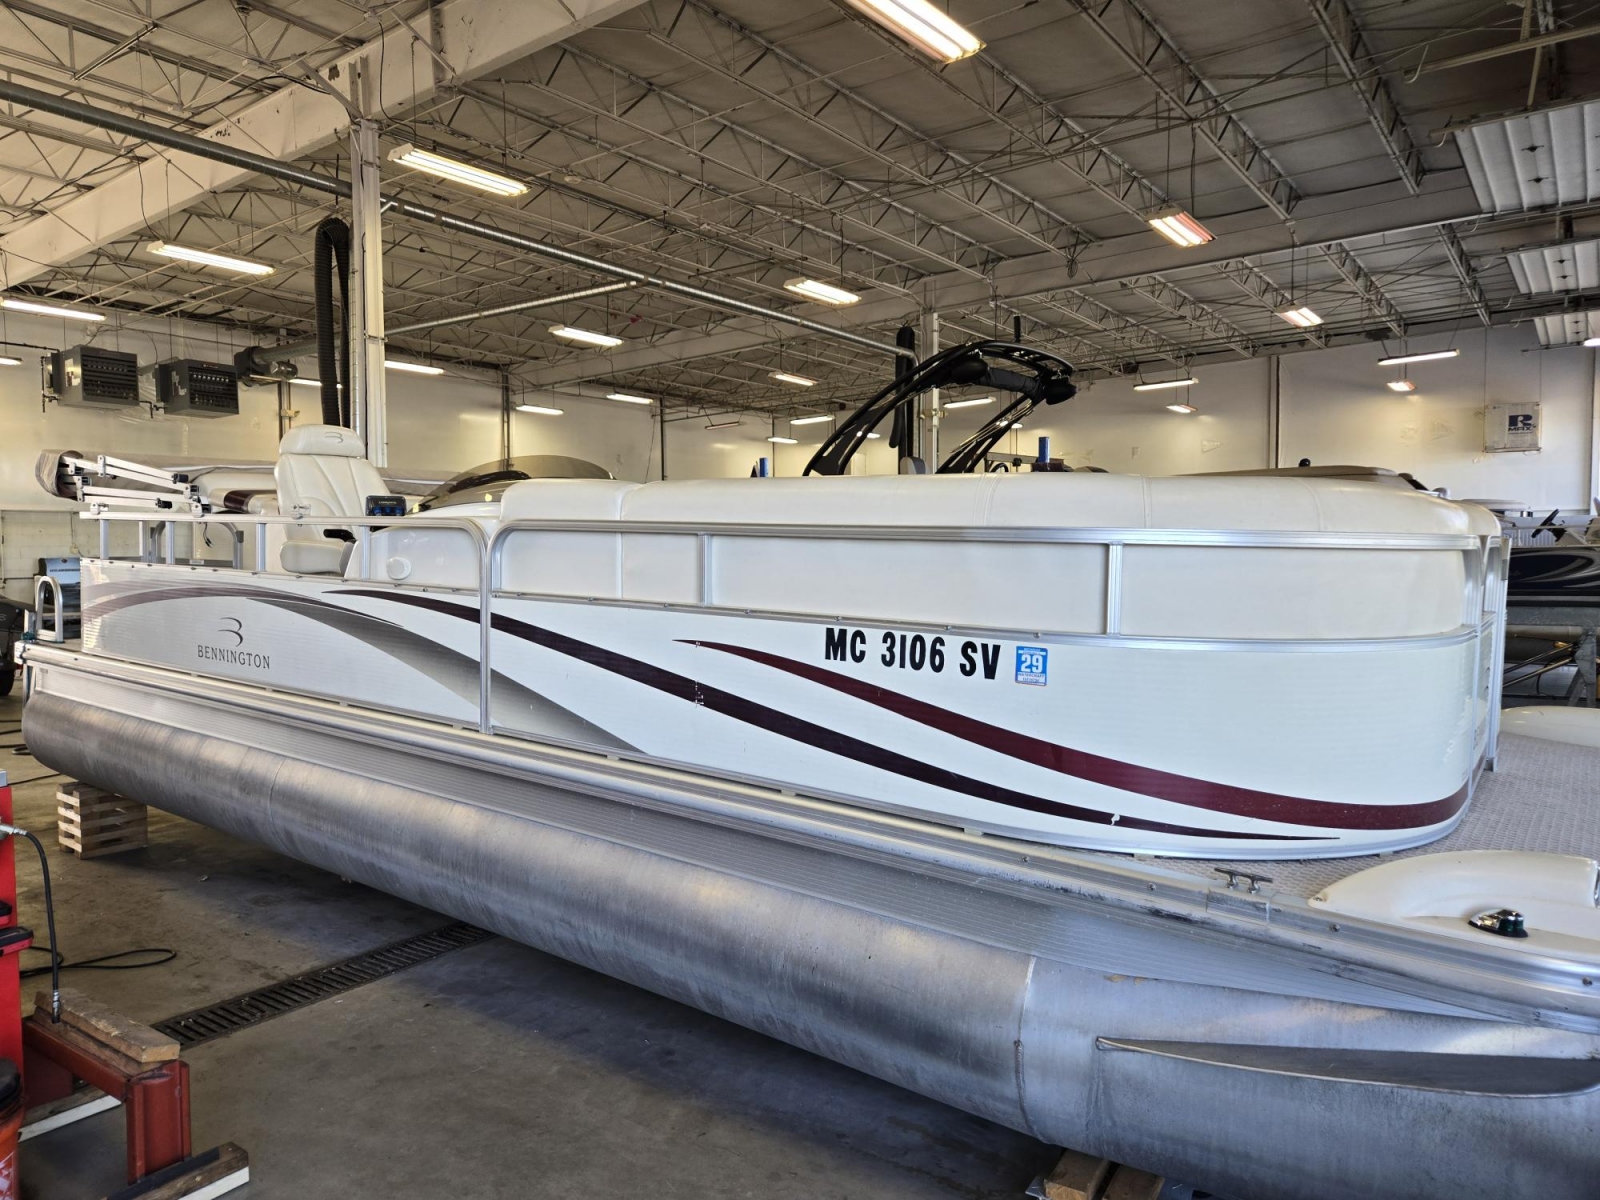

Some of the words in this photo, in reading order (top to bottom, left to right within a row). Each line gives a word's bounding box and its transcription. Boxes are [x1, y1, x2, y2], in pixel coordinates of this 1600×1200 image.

[197, 644, 271, 670] BENNINGTON
[825, 627, 867, 663] MC
[881, 631, 946, 673] 3106
[959, 640, 1001, 680] SV
[1021, 654, 1043, 673] 29
